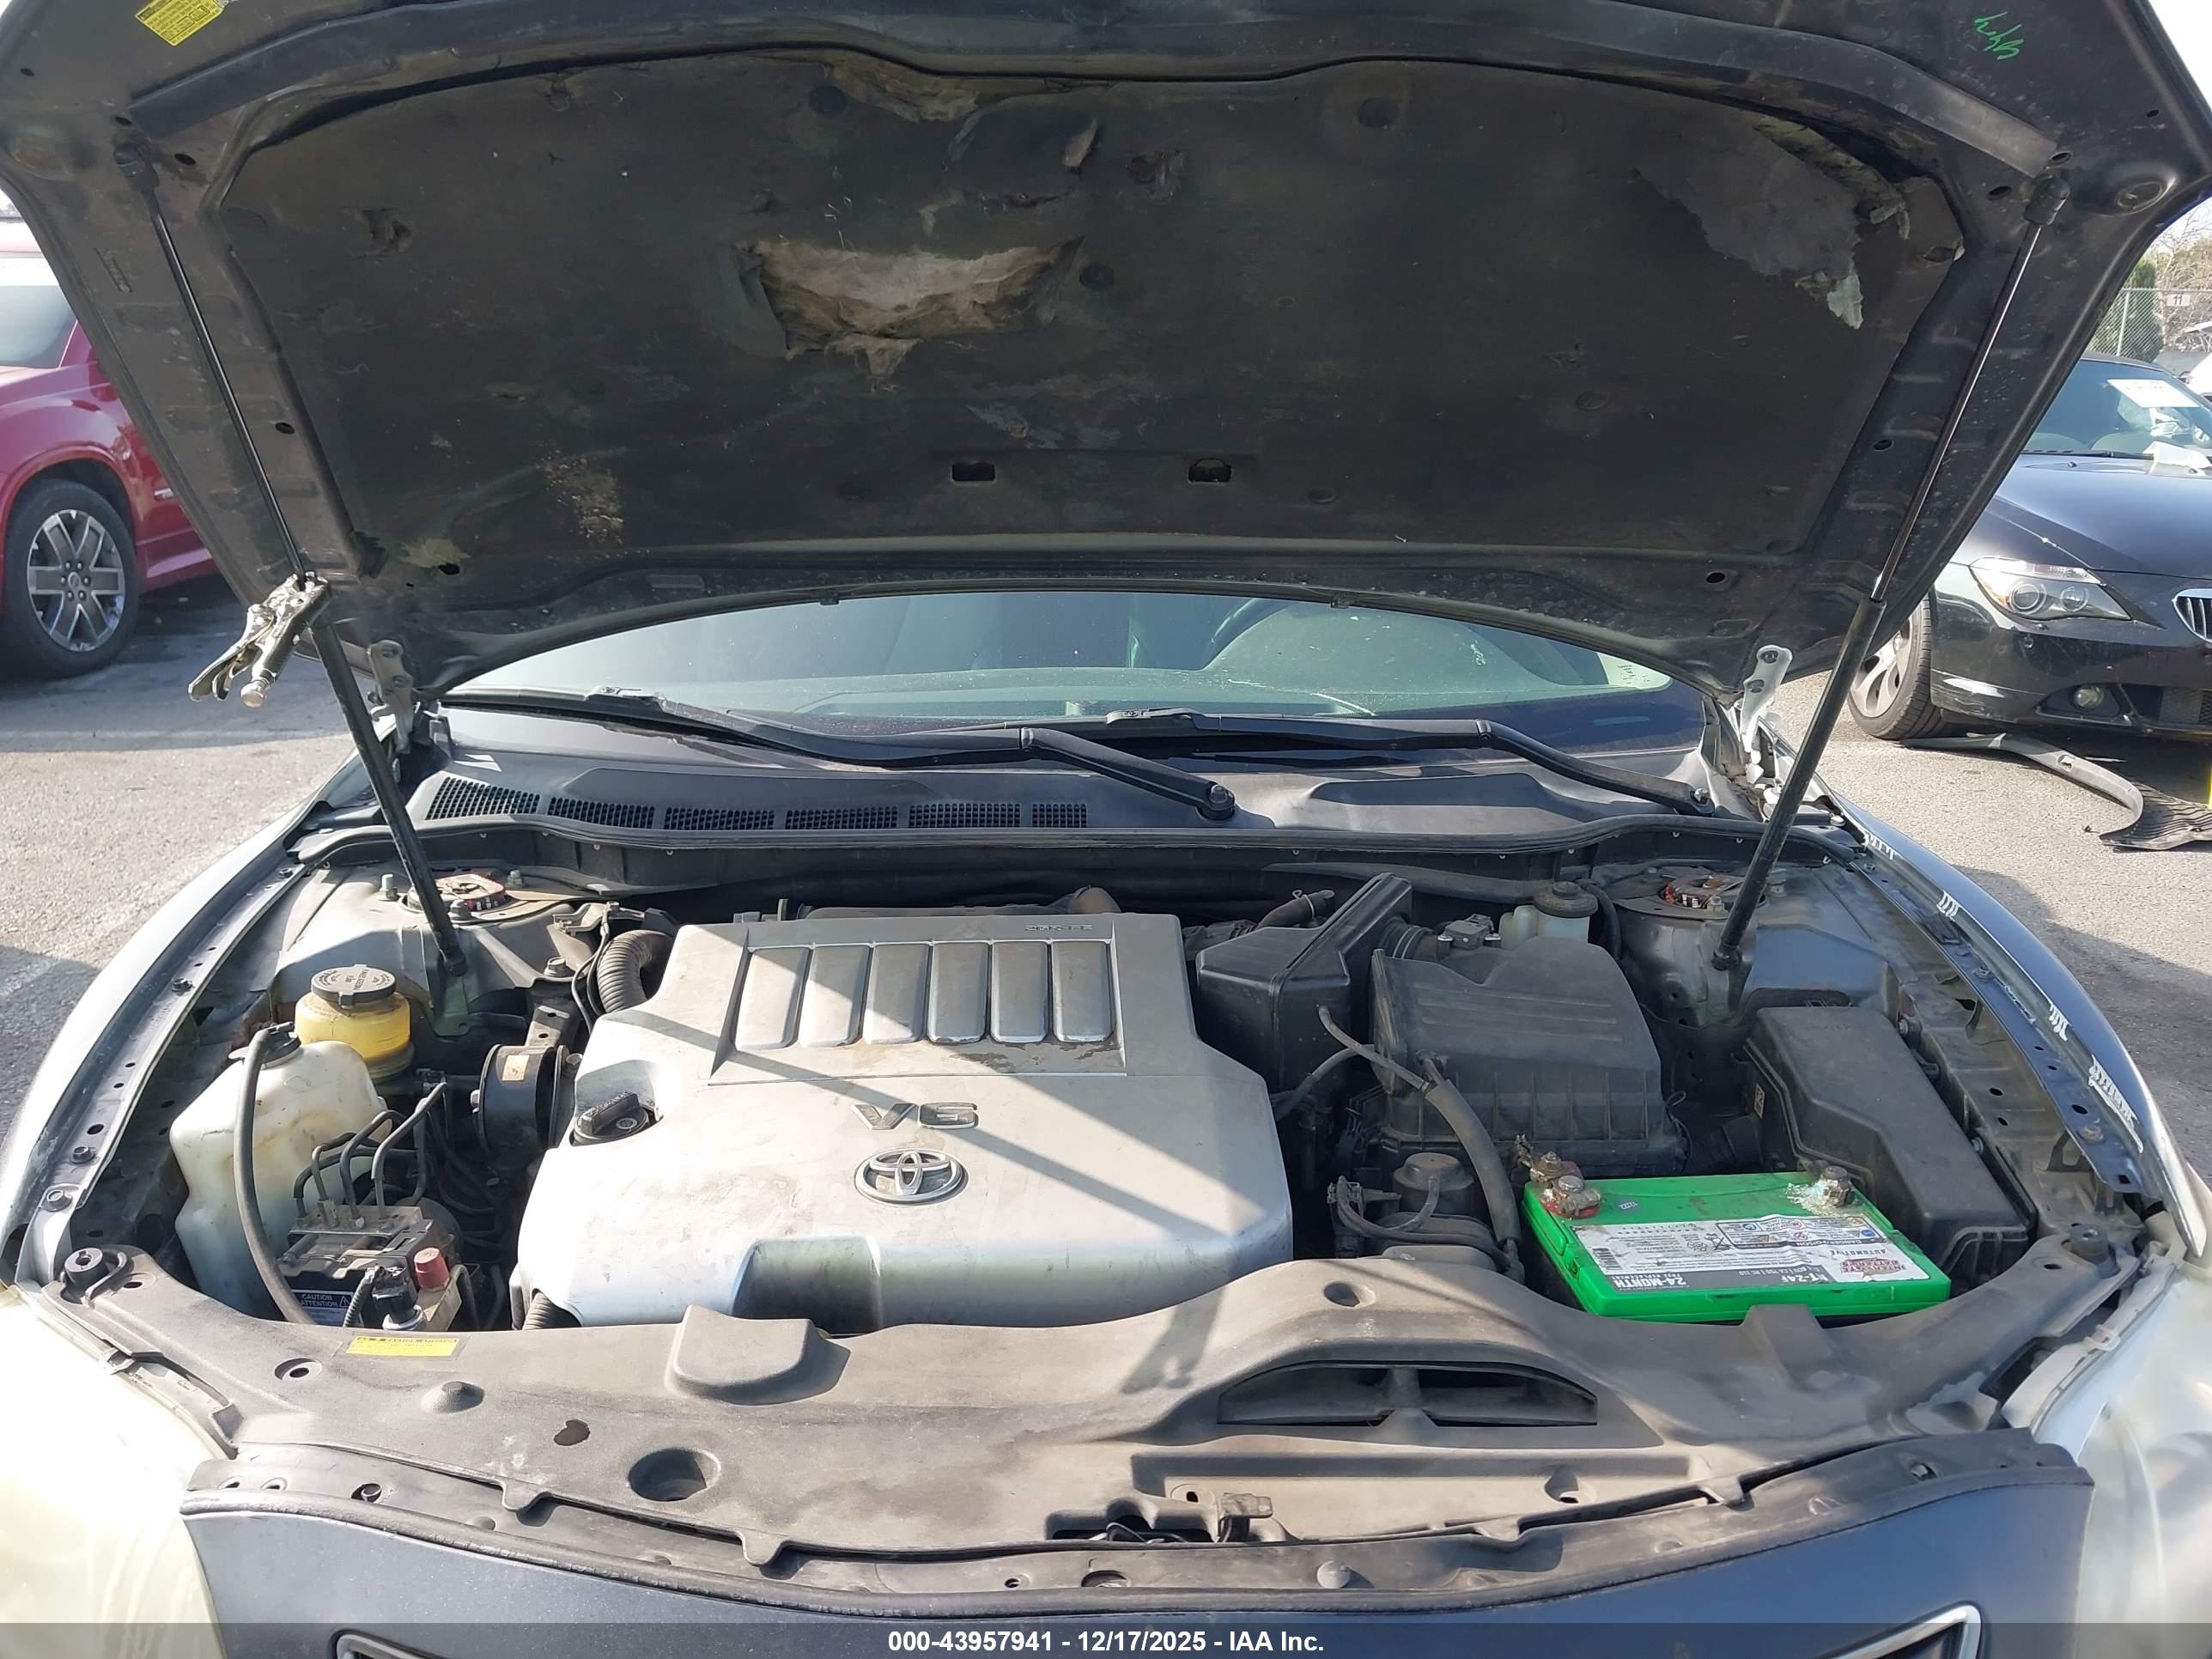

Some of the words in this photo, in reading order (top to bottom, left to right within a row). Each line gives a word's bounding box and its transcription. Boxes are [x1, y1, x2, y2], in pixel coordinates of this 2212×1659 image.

[2173, 295, 2183, 305] 11
[851, 1102, 980, 1130] V6
[1613, 1277, 1687, 1287] 24-MONTH
